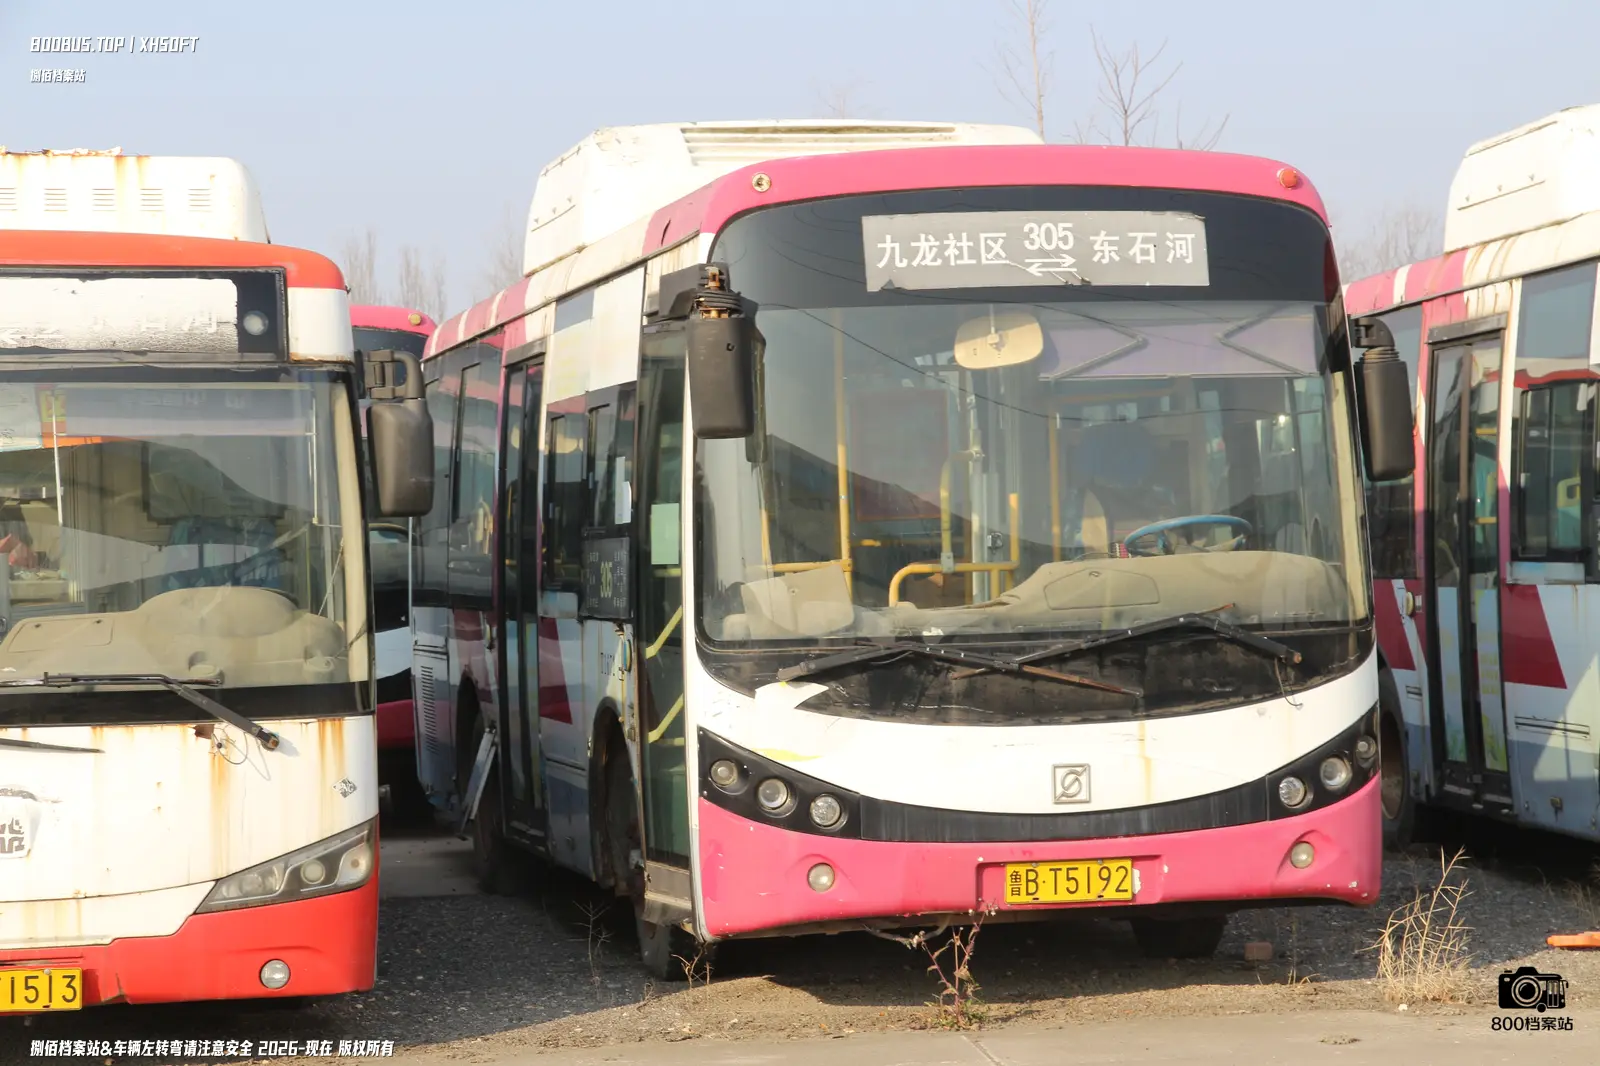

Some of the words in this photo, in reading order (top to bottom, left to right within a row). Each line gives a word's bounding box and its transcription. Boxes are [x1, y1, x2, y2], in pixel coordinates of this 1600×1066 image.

[877, 231, 1010, 268] 九龙社区
[1023, 222, 1075, 251] 305
[1090, 229, 1197, 265] 东石河
[601, 561, 613, 598] 305
[0, 974, 78, 1005] 1513
